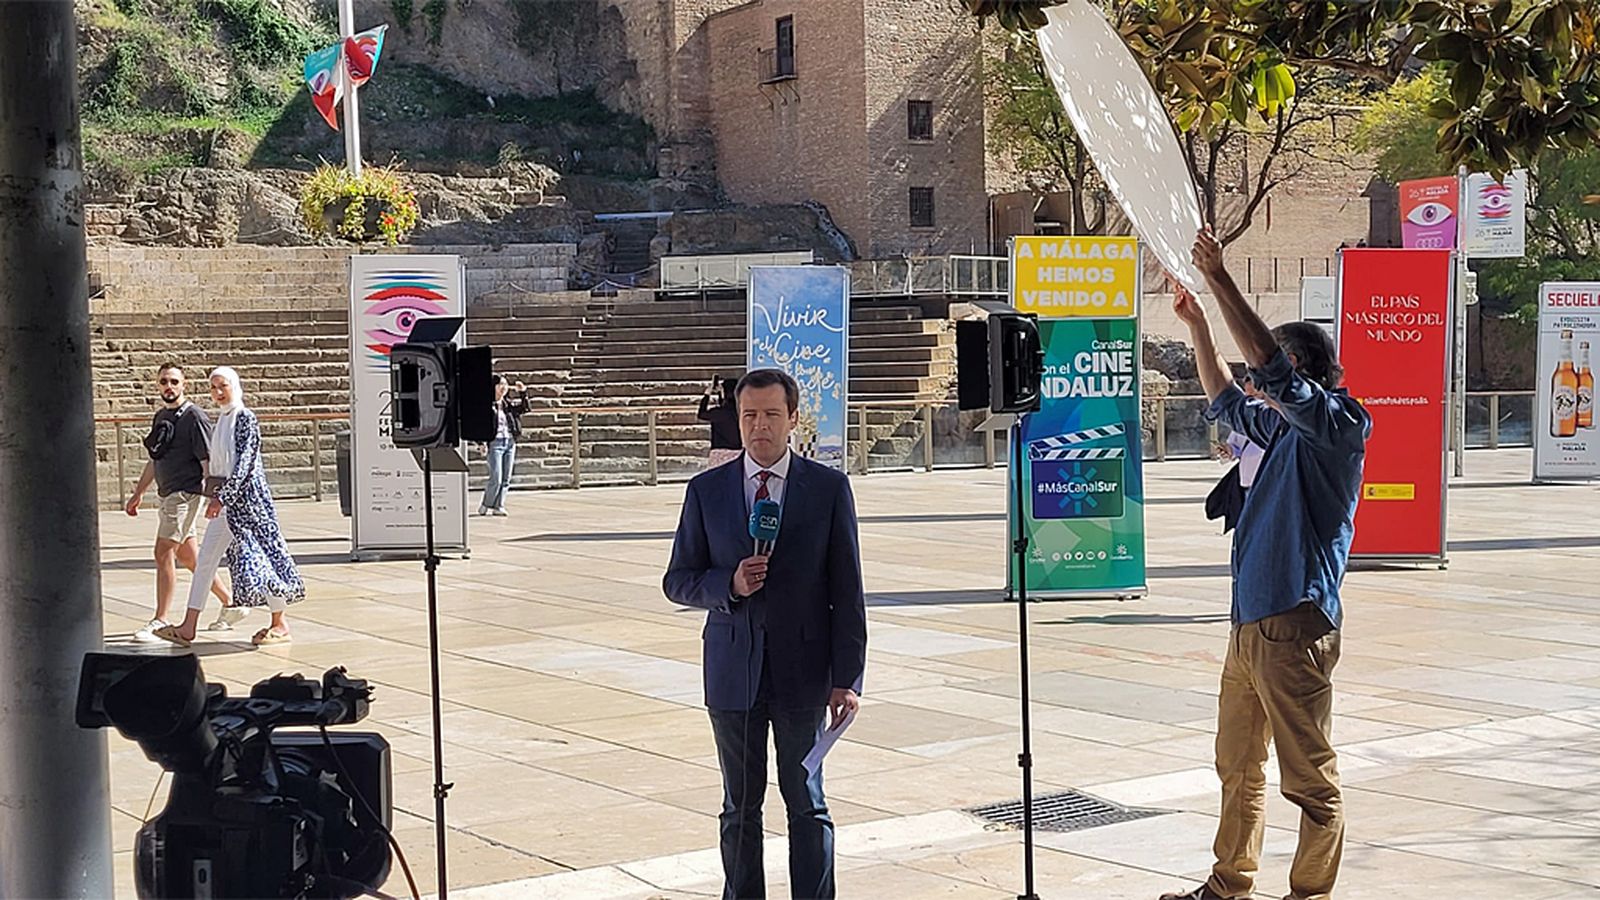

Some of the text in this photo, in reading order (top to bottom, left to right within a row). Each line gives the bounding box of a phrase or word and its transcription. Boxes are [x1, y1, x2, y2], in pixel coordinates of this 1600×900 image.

[1018, 240, 1136, 259] A MÁLAGA
[1038, 267, 1115, 283] HEMOS
[1022, 290, 1128, 307] VENIDO A
[1371, 294, 1420, 308] EL PAÍS
[1548, 292, 1600, 306] SECUEL
[753, 296, 845, 334] Vivir
[1346, 311, 1443, 326] MÁS RICO DEL
[1367, 329, 1422, 342] MUNDO
[774, 333, 831, 366] Cine
[1041, 352, 1132, 375] on el CINE
[1040, 376, 1133, 398] NDALUZ
[1037, 481, 1118, 494] #MásCanalSur
